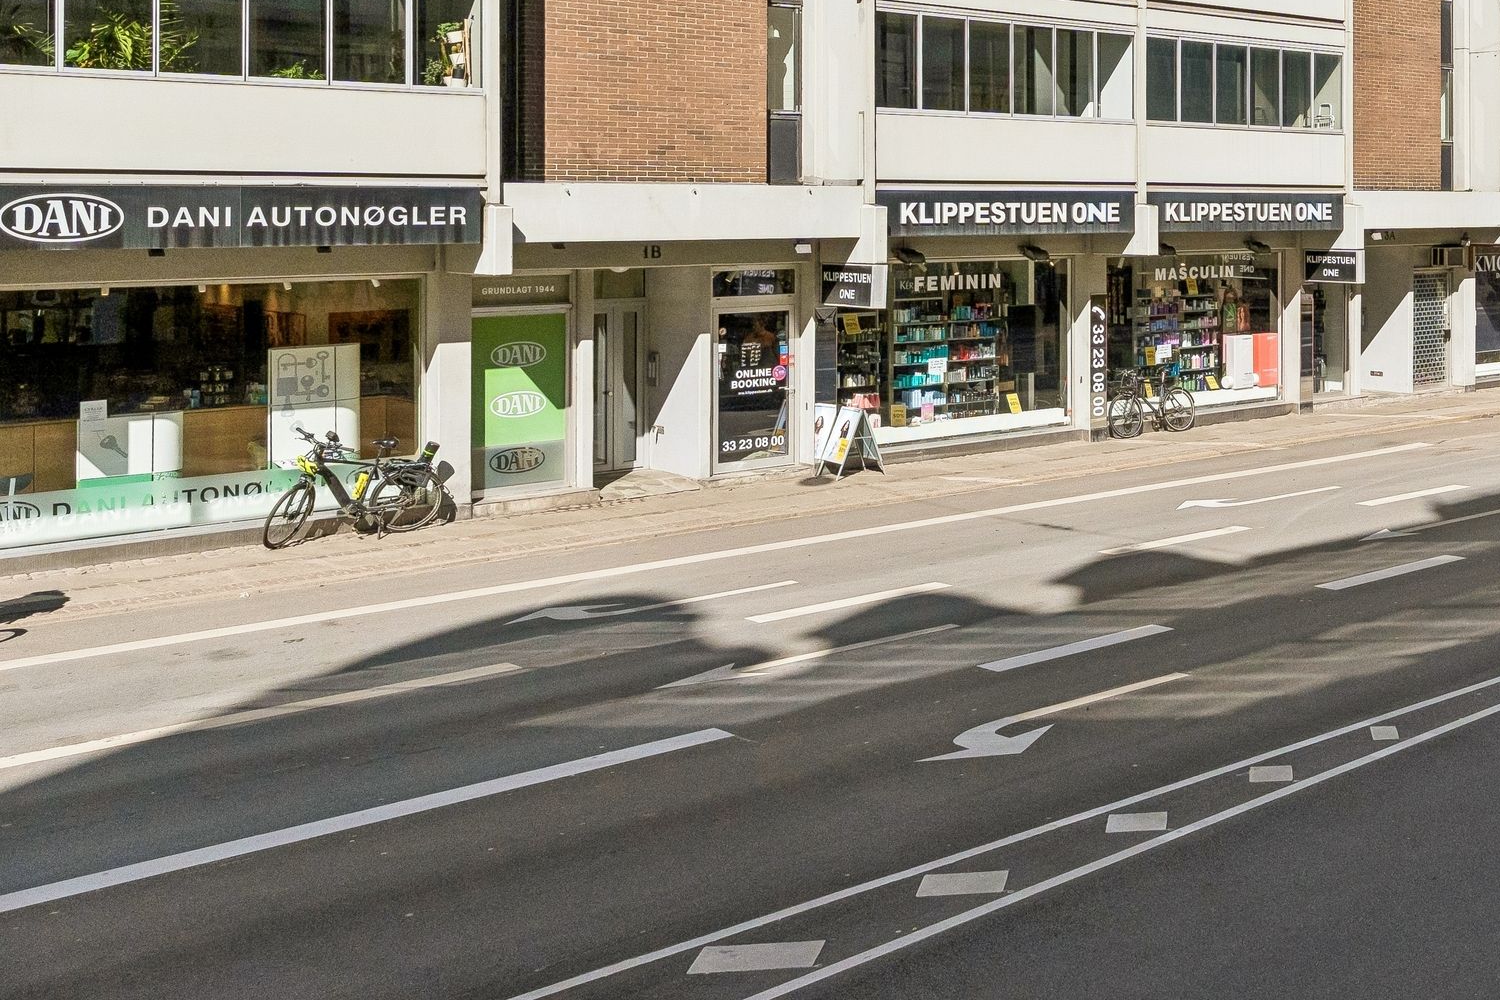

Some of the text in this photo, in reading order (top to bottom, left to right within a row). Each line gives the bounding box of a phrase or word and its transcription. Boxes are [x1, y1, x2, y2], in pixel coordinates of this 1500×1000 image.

[11, 199, 113, 238] DANI
[146, 206, 467, 228] DANI AUTONØGLER
[899, 201, 1120, 226] KLIPPESTUEN ONE
[1164, 202, 1333, 224] KLIPPESTUEN ONE
[643, 245, 661, 259] 1B
[1305, 256, 1356, 265] KLIPPESTUEN
[823, 271, 872, 284] KLIPPESTUEN
[1154, 265, 1234, 281] MASCULIN
[1323, 268, 1339, 277] ONE
[481, 285, 555, 295] GRUNDLAGT 1944
[914, 273, 1001, 292] FEMININ
[839, 288, 855, 300] ONE
[497, 344, 540, 366] DANI
[736, 368, 772, 379] ONLINE
[1092, 325, 1105, 417] 33 23 08 00
[731, 377, 776, 390] BOOKING
[497, 394, 541, 416] DANI
[722, 435, 784, 452] 33 23 08 00
[496, 450, 539, 472] DANI
